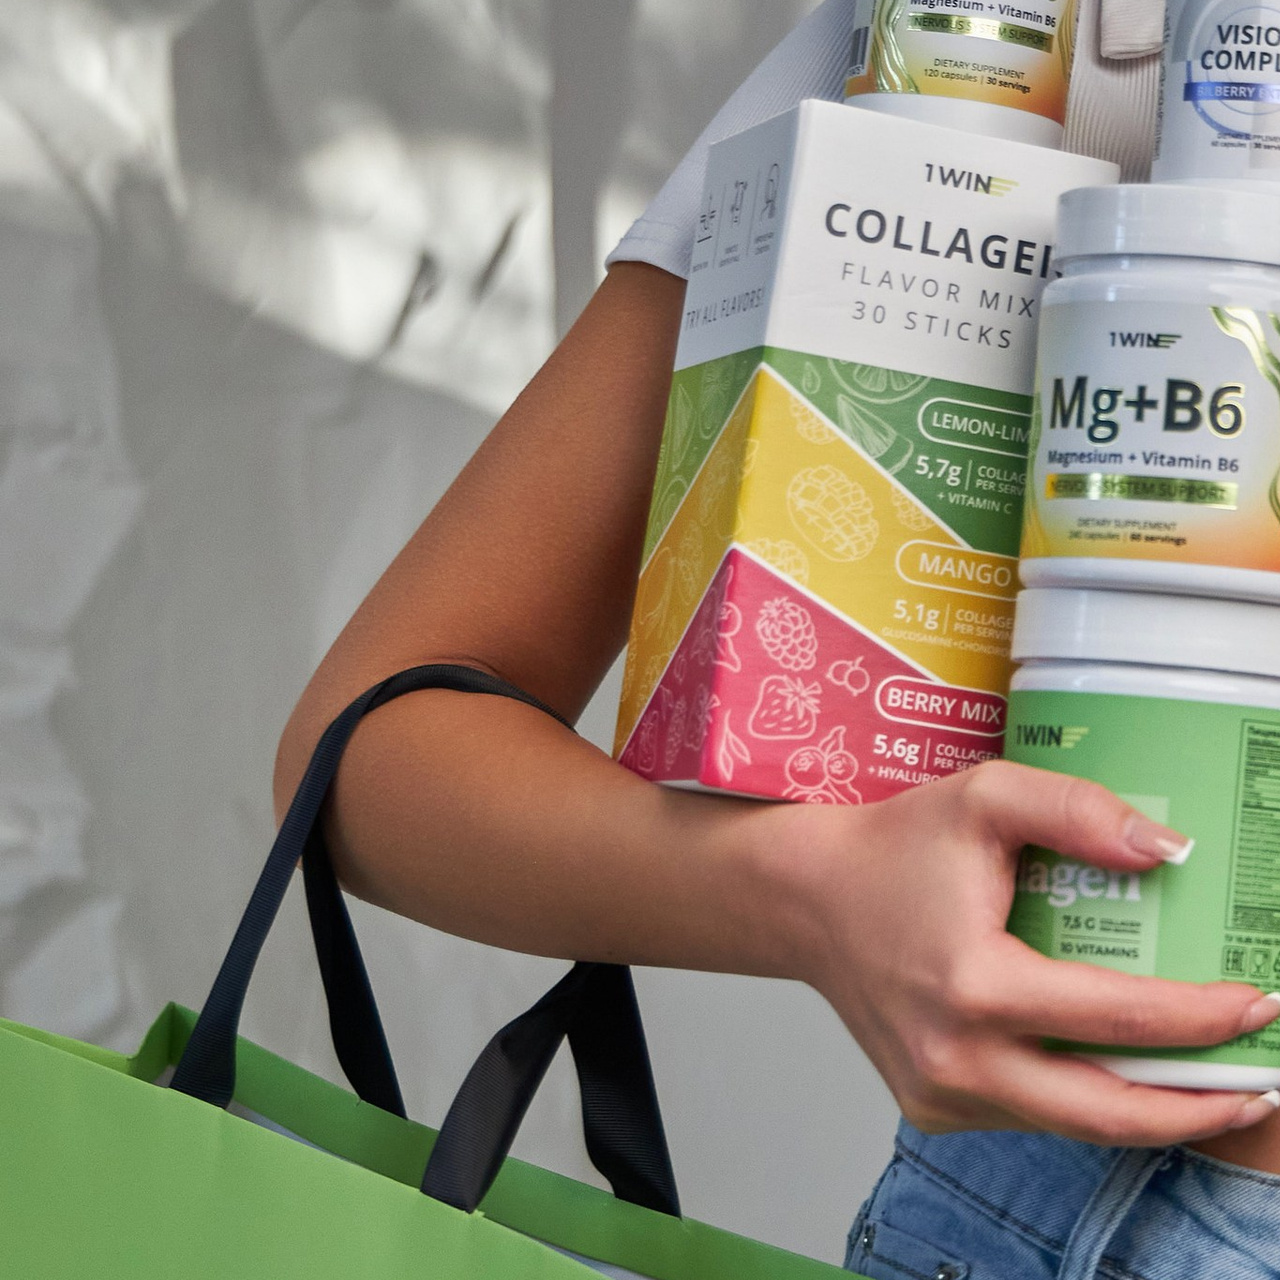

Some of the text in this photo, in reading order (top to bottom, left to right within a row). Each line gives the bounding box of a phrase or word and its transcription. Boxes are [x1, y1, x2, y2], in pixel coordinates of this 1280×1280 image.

[998, 4, 1043, 24] Vitamin
[1044, 15, 1056, 28] B6
[914, 17, 1049, 46] NERVOUS SYSTEM SUPPORT
[924, 69, 1031, 94] 120 capsules 30 servings
[934, 58, 1025, 80] DIETARY SUPPLEMENT
[1196, 86, 1256, 98] BILBERRY
[842, 262, 1035, 318] FLAVOR MIX
[686, 308, 701, 331] TRY
[703, 301, 718, 323] ALL
[852, 301, 1013, 349] 30 STICKS
[1050, 375, 1246, 444] Mg+B6
[915, 455, 962, 487] 5,7g
[1048, 450, 1123, 468] Magnesium
[1142, 452, 1211, 470] Vitamin
[1218, 458, 1240, 472] B6
[976, 479, 995, 491] PER
[1103, 480, 1155, 496] SYSTEM
[1157, 484, 1227, 501] SUPPORT
[948, 492, 1001, 512] VITAMIN
[1003, 503, 1013, 514] C
[920, 552, 1012, 587] MANGO
[894, 599, 940, 631] 5,1g
[954, 622, 974, 635] PER
[888, 688, 1002, 724] BERRY MIX
[873, 734, 921, 766] 5,6g
[934, 757, 954, 770] PER
[1076, 943, 1140, 959] VITAMINS
